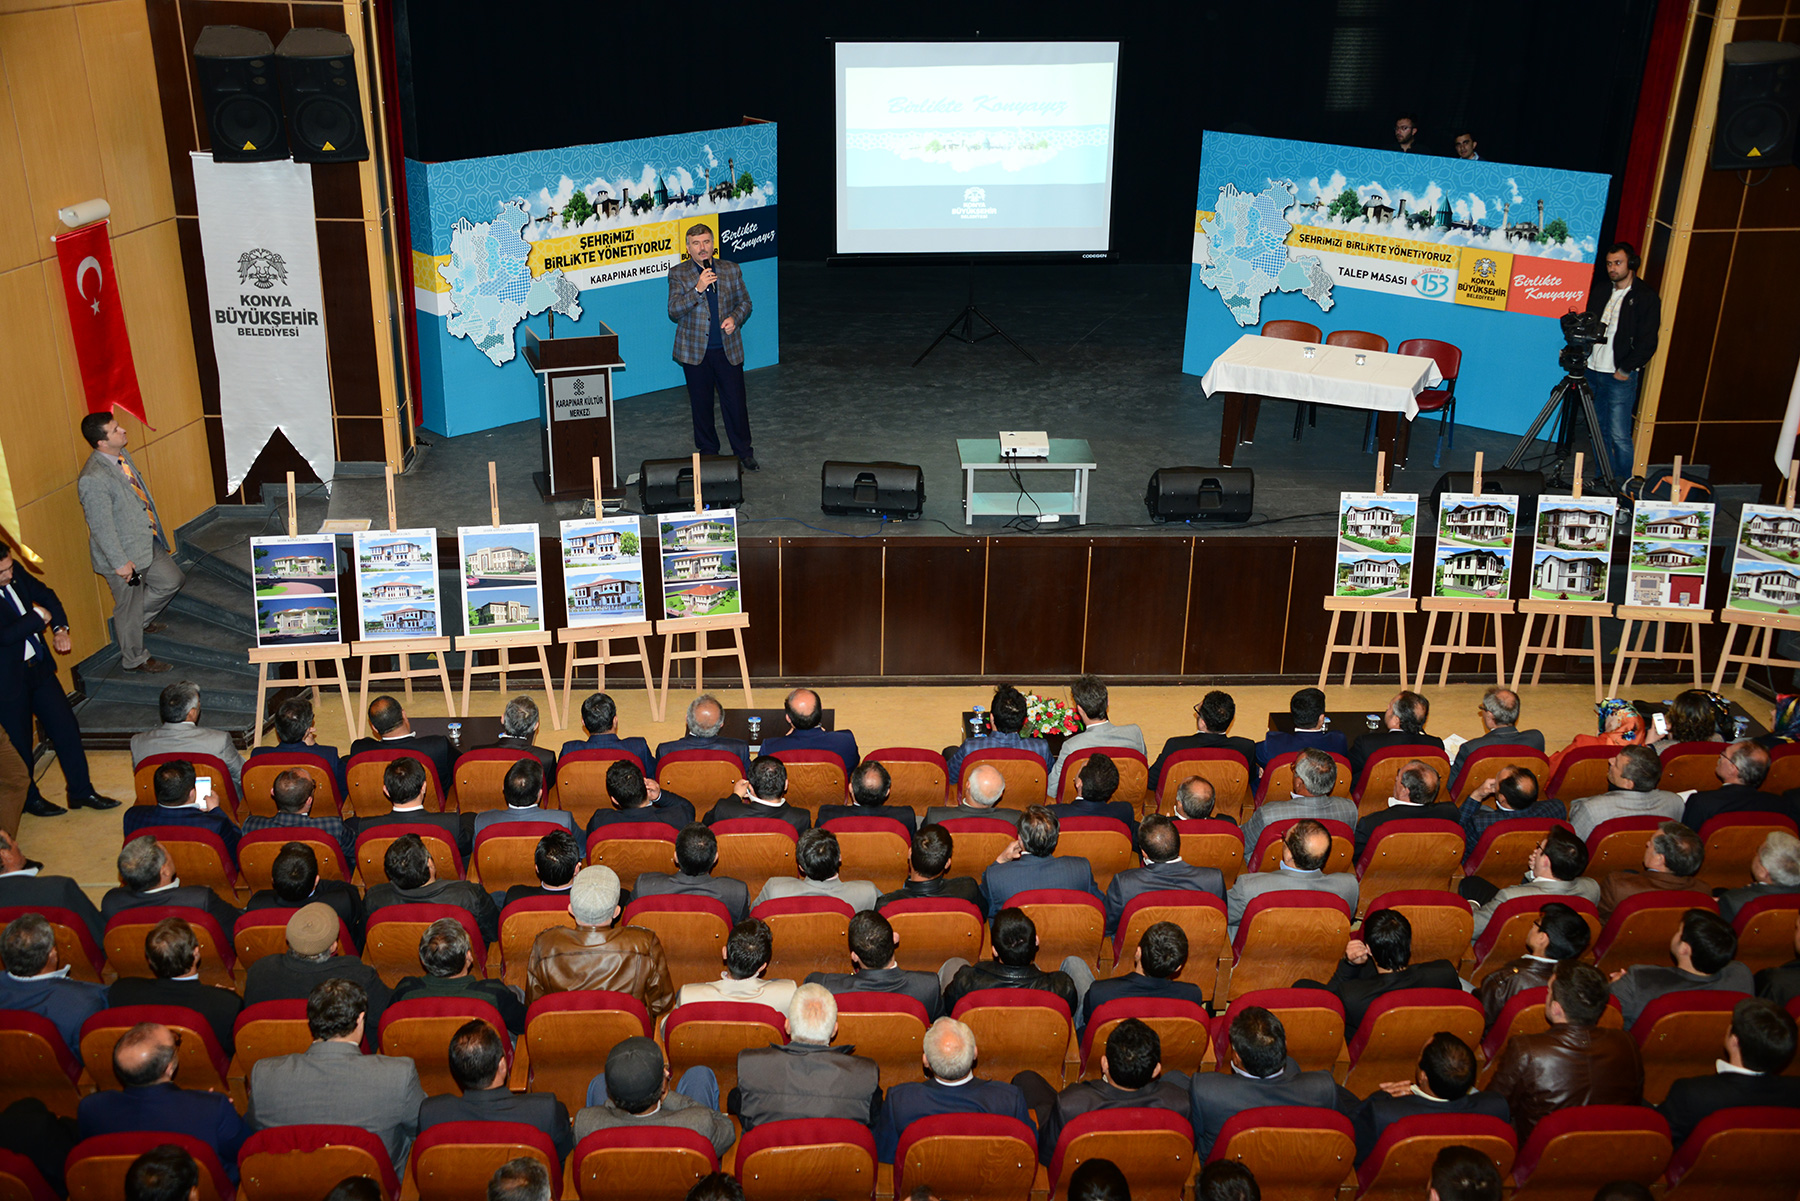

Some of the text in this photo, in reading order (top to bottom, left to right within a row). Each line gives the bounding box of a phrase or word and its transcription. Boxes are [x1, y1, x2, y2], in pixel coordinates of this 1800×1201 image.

[887, 96, 964, 114] Birlikte
[580, 229, 635, 250] ŞEHRİMİZİ
[721, 222, 758, 244] Birlikte
[731, 229, 776, 253] Konyayız
[544, 251, 596, 270] BİRLİKTE
[597, 238, 672, 261] YÖNETİYORUZ
[1299, 233, 1452, 263] ŞEHRİMİZİ BİRLİKTE YÖNETİYORUZ
[590, 260, 671, 285] KARAPINAR MECLİSİ
[1338, 266, 1369, 280] TALEP
[1370, 271, 1408, 285] MASASI
[1513, 274, 1562, 288] Birlikte
[1420, 272, 1450, 293] 153
[1457, 282, 1507, 297] BÜYÜKŞEHİR
[1470, 277, 1496, 287] KONYA
[240, 295, 292, 307] KONYA
[1466, 292, 1496, 301] BELEDİYESİ
[1524, 286, 1584, 301] Konyayız
[215, 306, 319, 327] BÜYÜKŞEHİR
[237, 327, 299, 337] BELEDİYESİ
[556, 395, 603, 408] KARAPINAR KÜLTÜR
